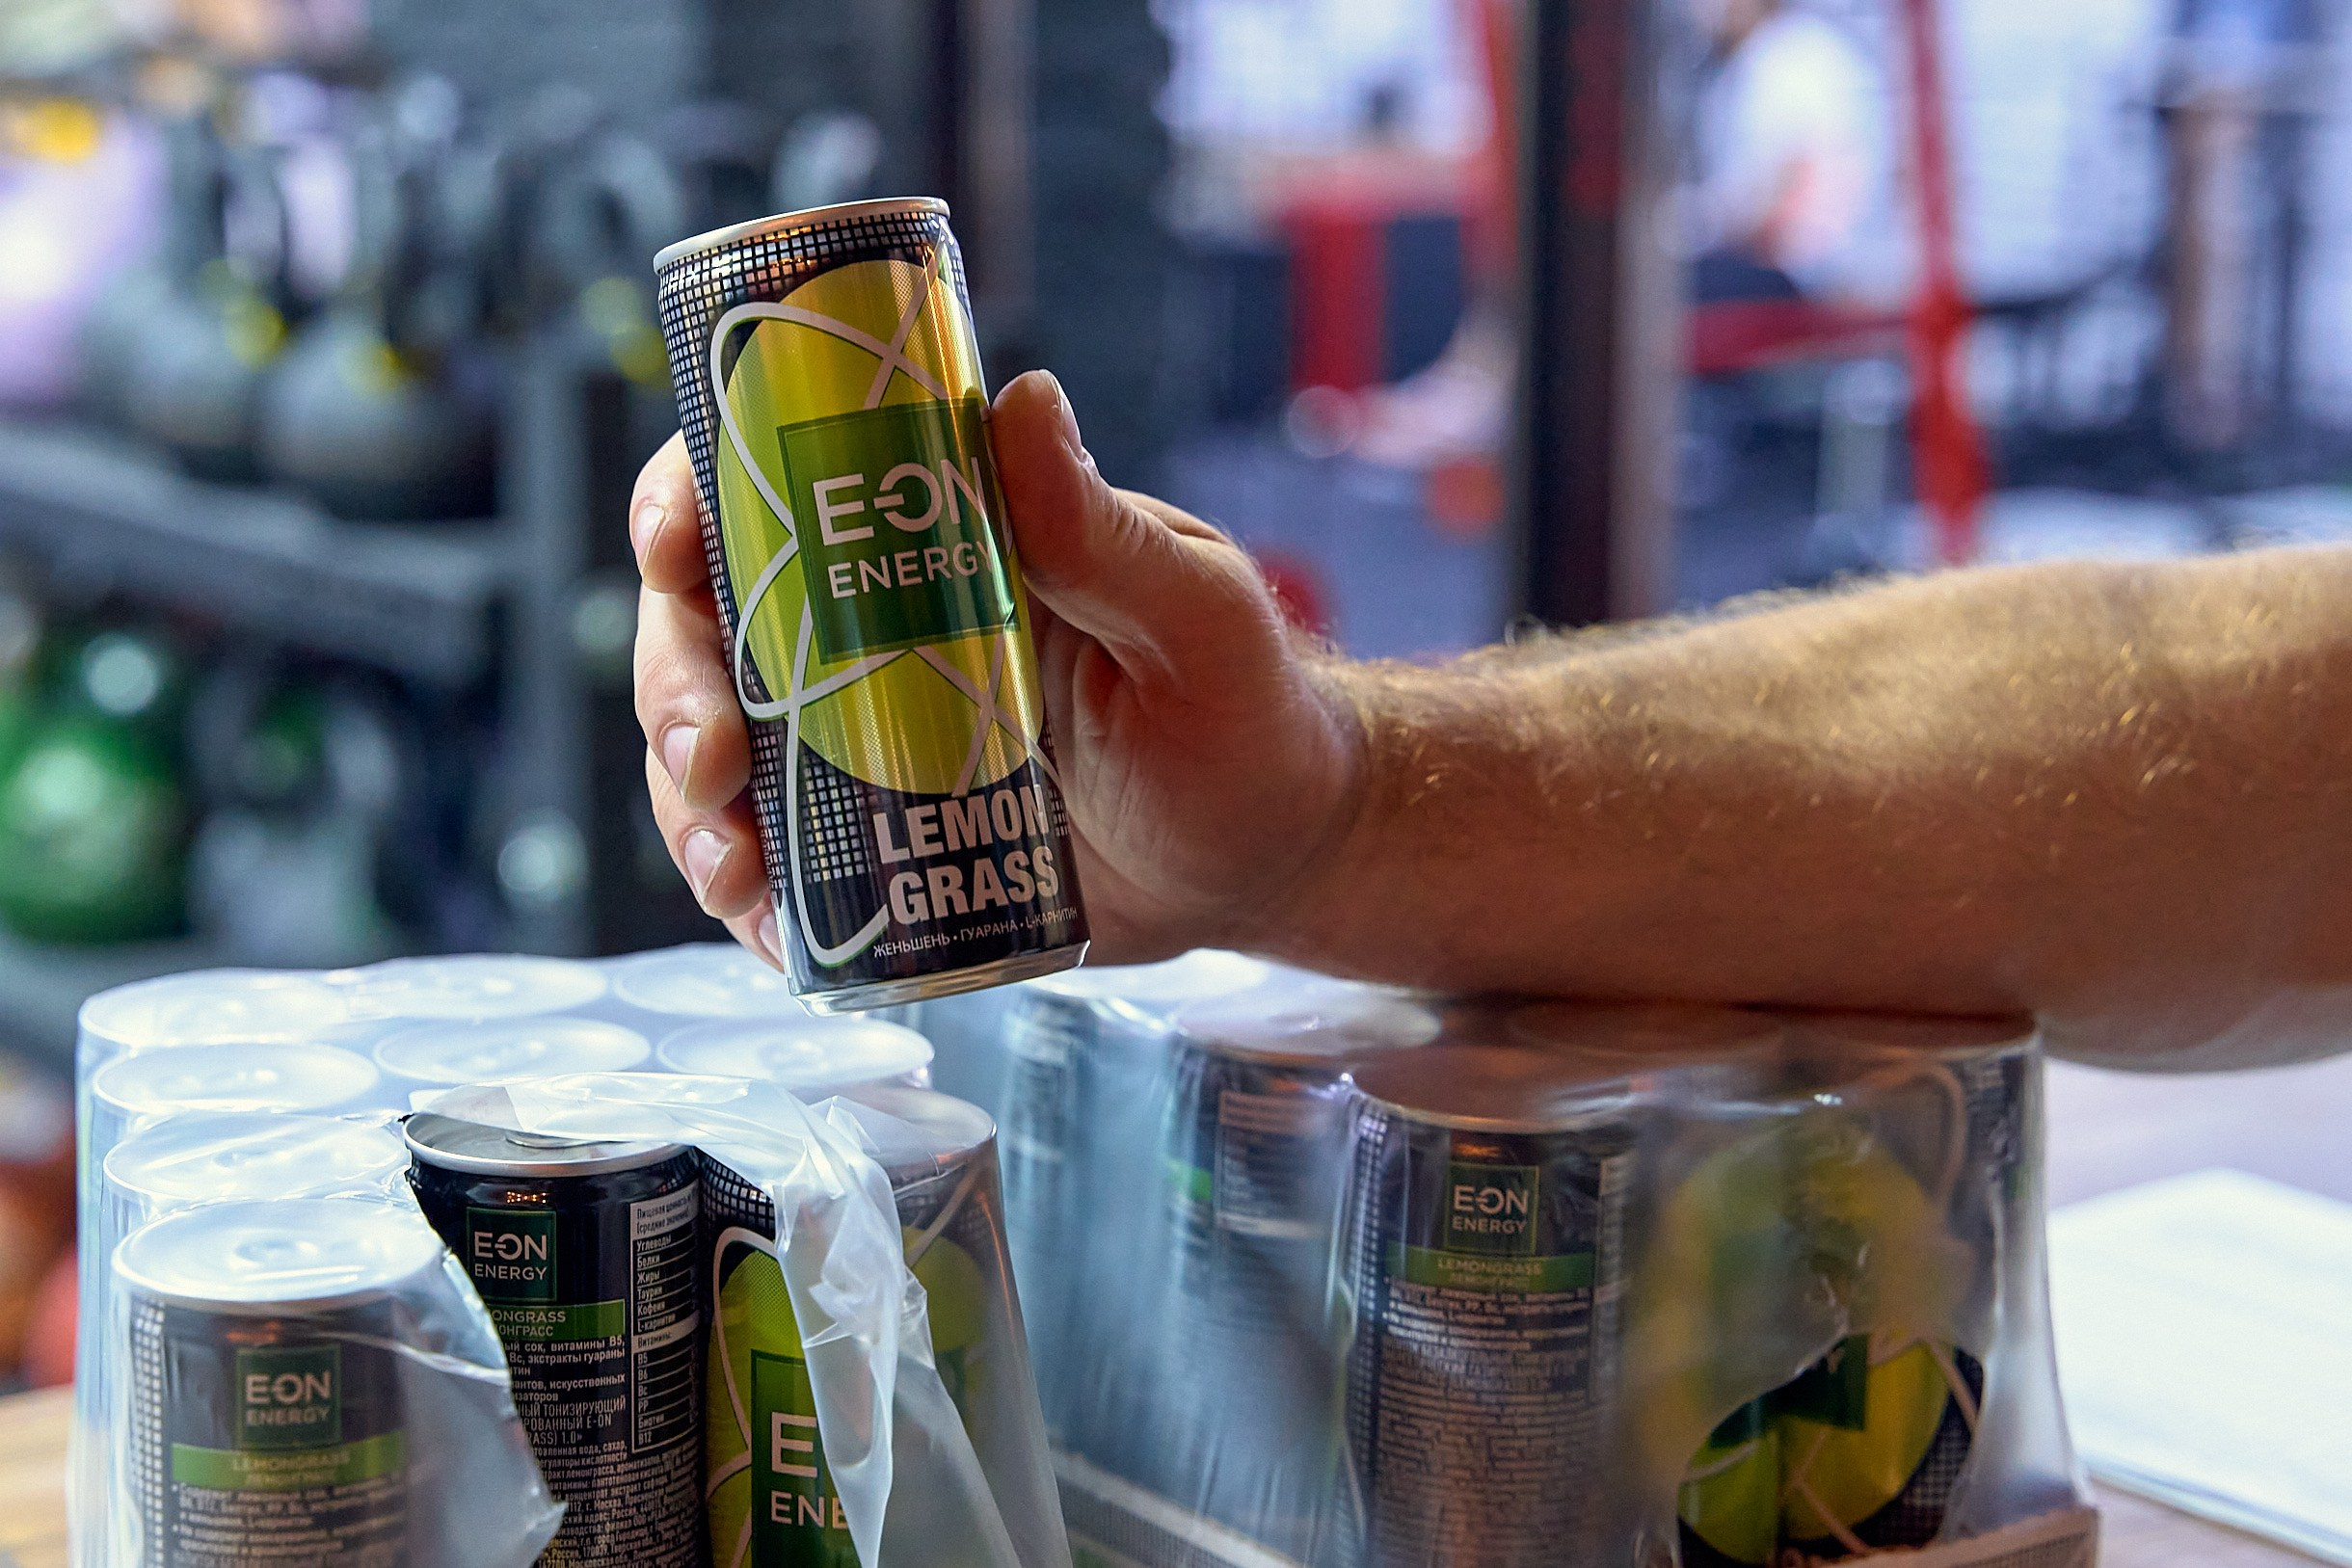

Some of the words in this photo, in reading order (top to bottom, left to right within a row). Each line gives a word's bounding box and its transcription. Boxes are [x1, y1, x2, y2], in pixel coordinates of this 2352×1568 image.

[828, 541, 992, 598] ENERGY
[873, 784, 1050, 864] LEMON
[889, 845, 1059, 925] GRASS
[873, 933, 950, 958] ЖЕНЬШЕНЬ
[960, 921, 1019, 942] ГУАРАНА
[1452, 1215, 1528, 1235] ENERGY
[637, 1235, 672, 1252] Углеводы
[637, 1255, 660, 1268] Белки
[474, 1263, 548, 1280] ENERGY
[637, 1270, 660, 1285] Жиры
[491, 1310, 567, 1323] ONGRASS
[496, 1325, 553, 1336] ОНГРАСС
[551, 1340, 604, 1352] витамины
[527, 1351, 581, 1366] экстракты
[584, 1348, 626, 1364] гуараны
[549, 1373, 626, 1391] искусственных
[544, 1395, 627, 1417] ТОНИЗИРУЮЩИЙ
[522, 1415, 583, 1431] РОВАННЫЙ
